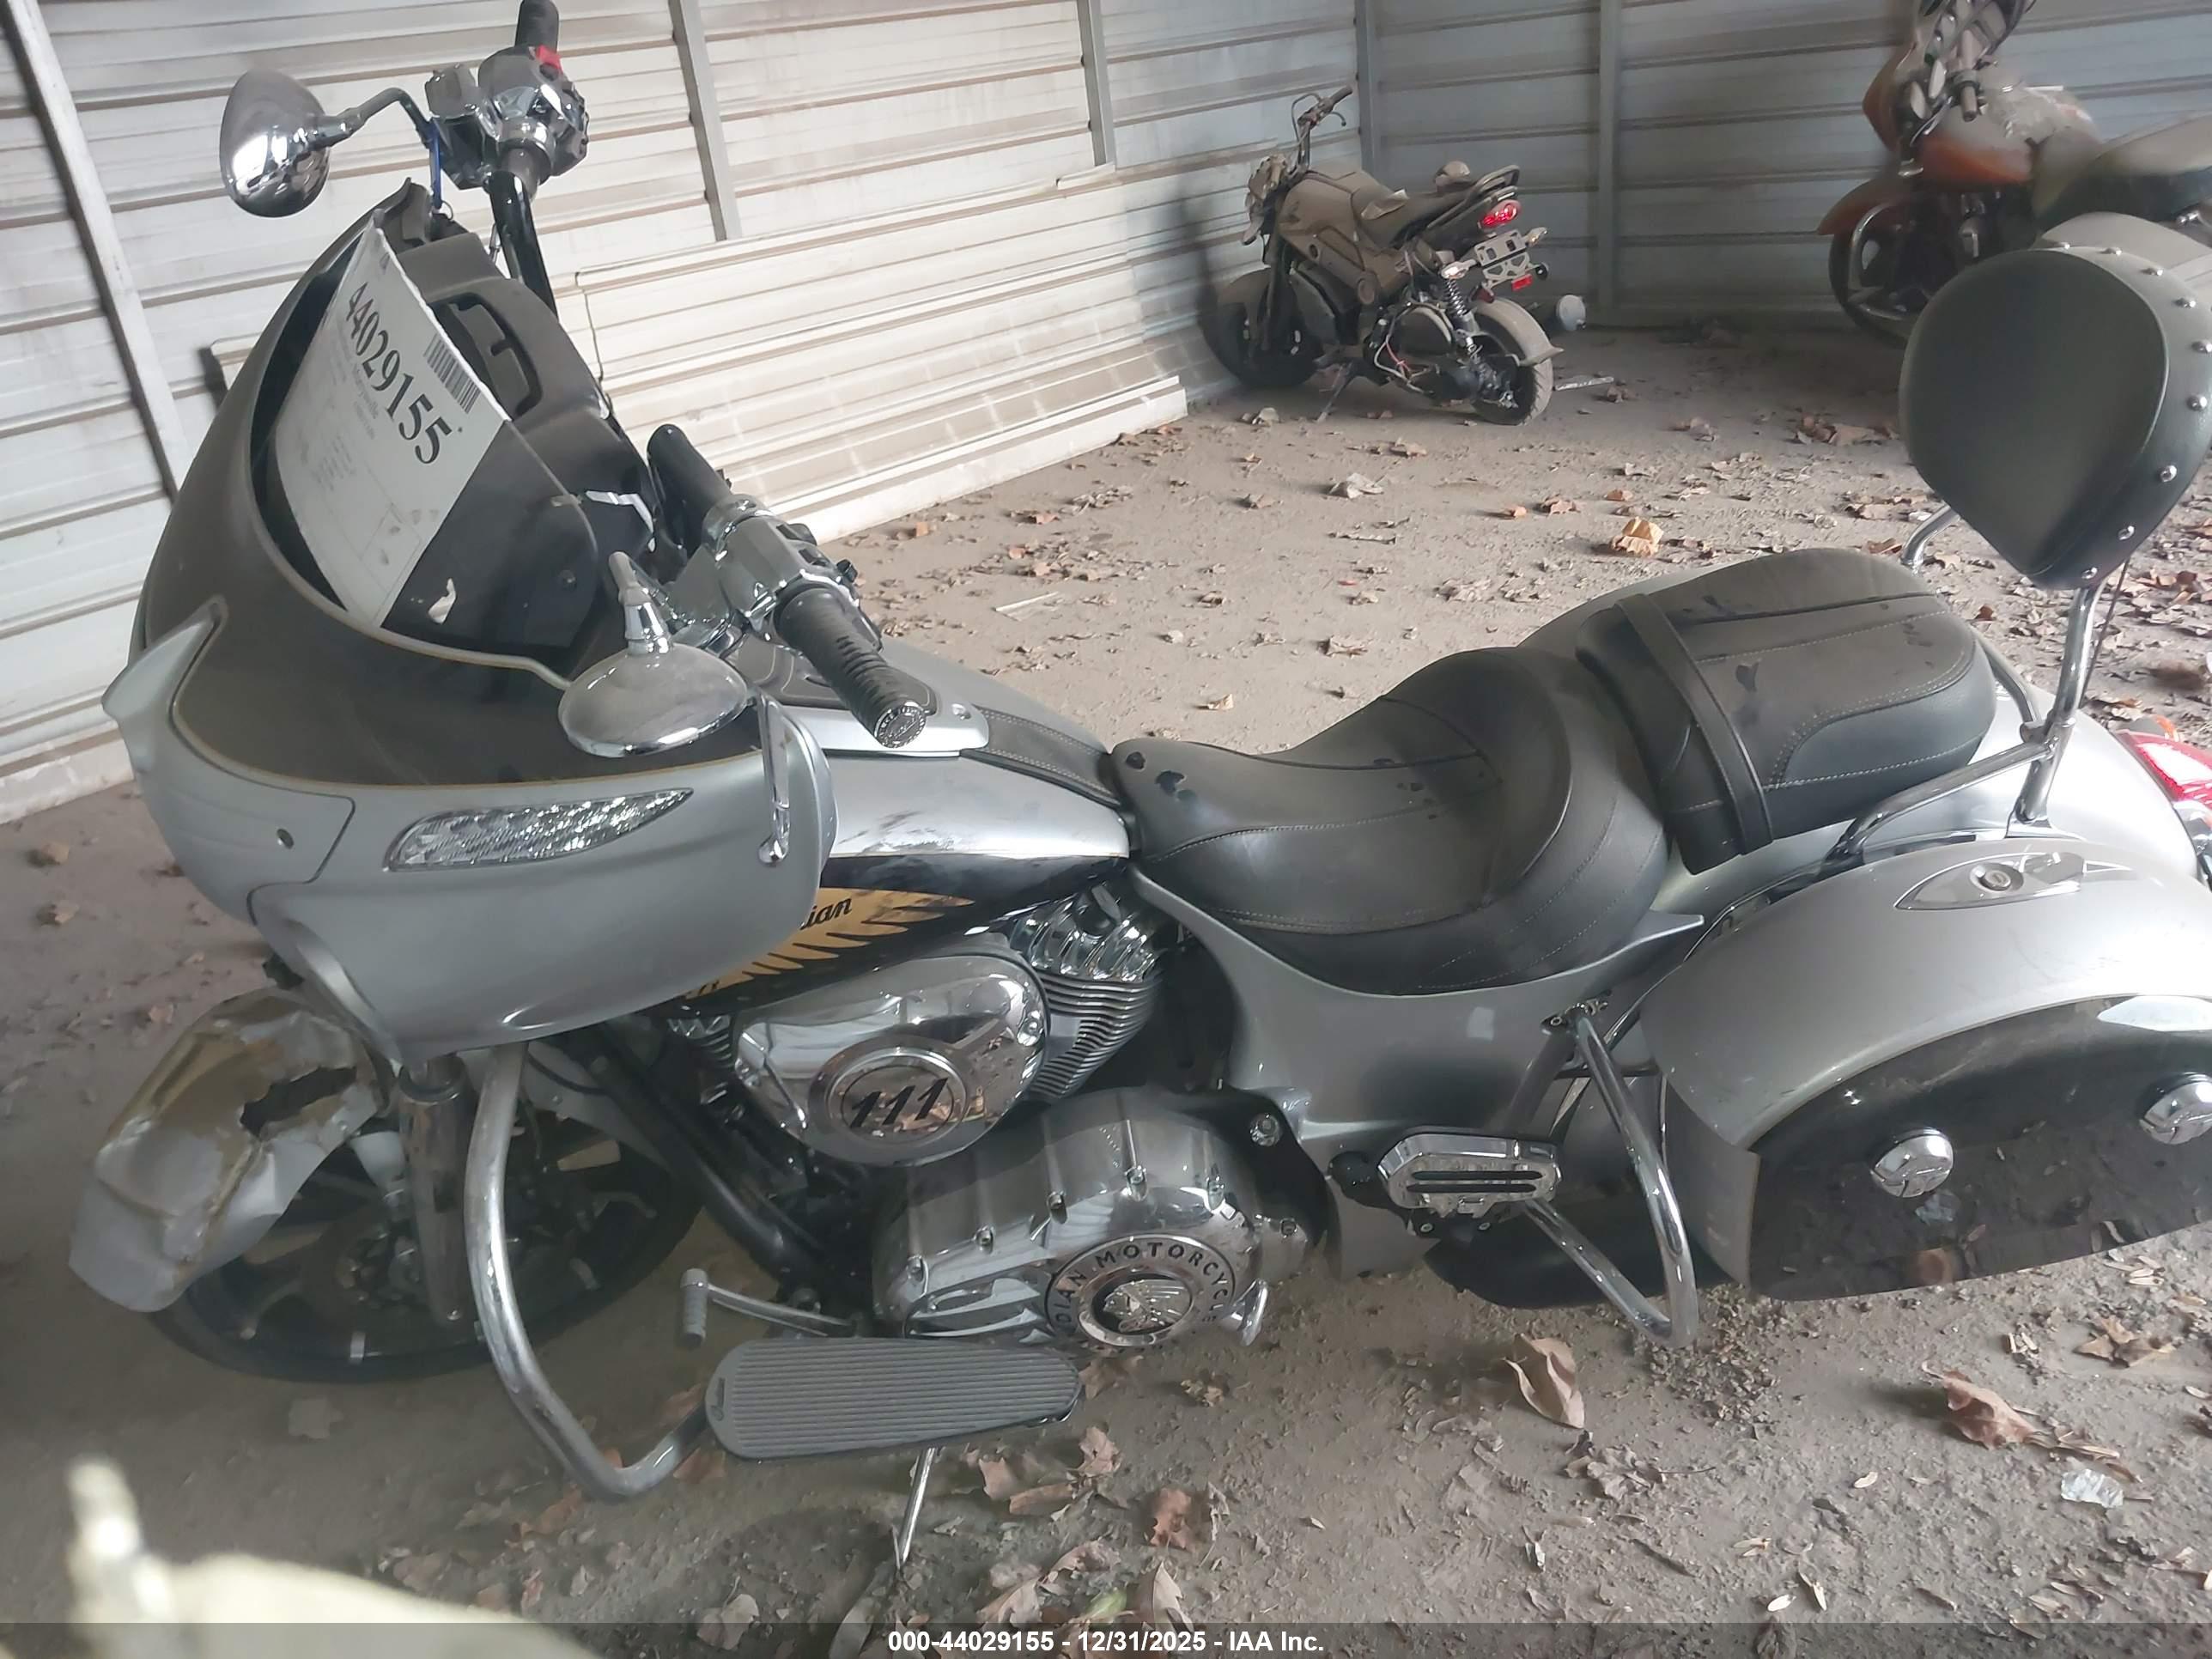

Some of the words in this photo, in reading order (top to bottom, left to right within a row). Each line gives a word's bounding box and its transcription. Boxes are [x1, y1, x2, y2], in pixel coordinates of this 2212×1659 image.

[345, 280, 453, 465] 44029155
[799, 897, 853, 931] ian
[850, 1077, 948, 1128] 111
